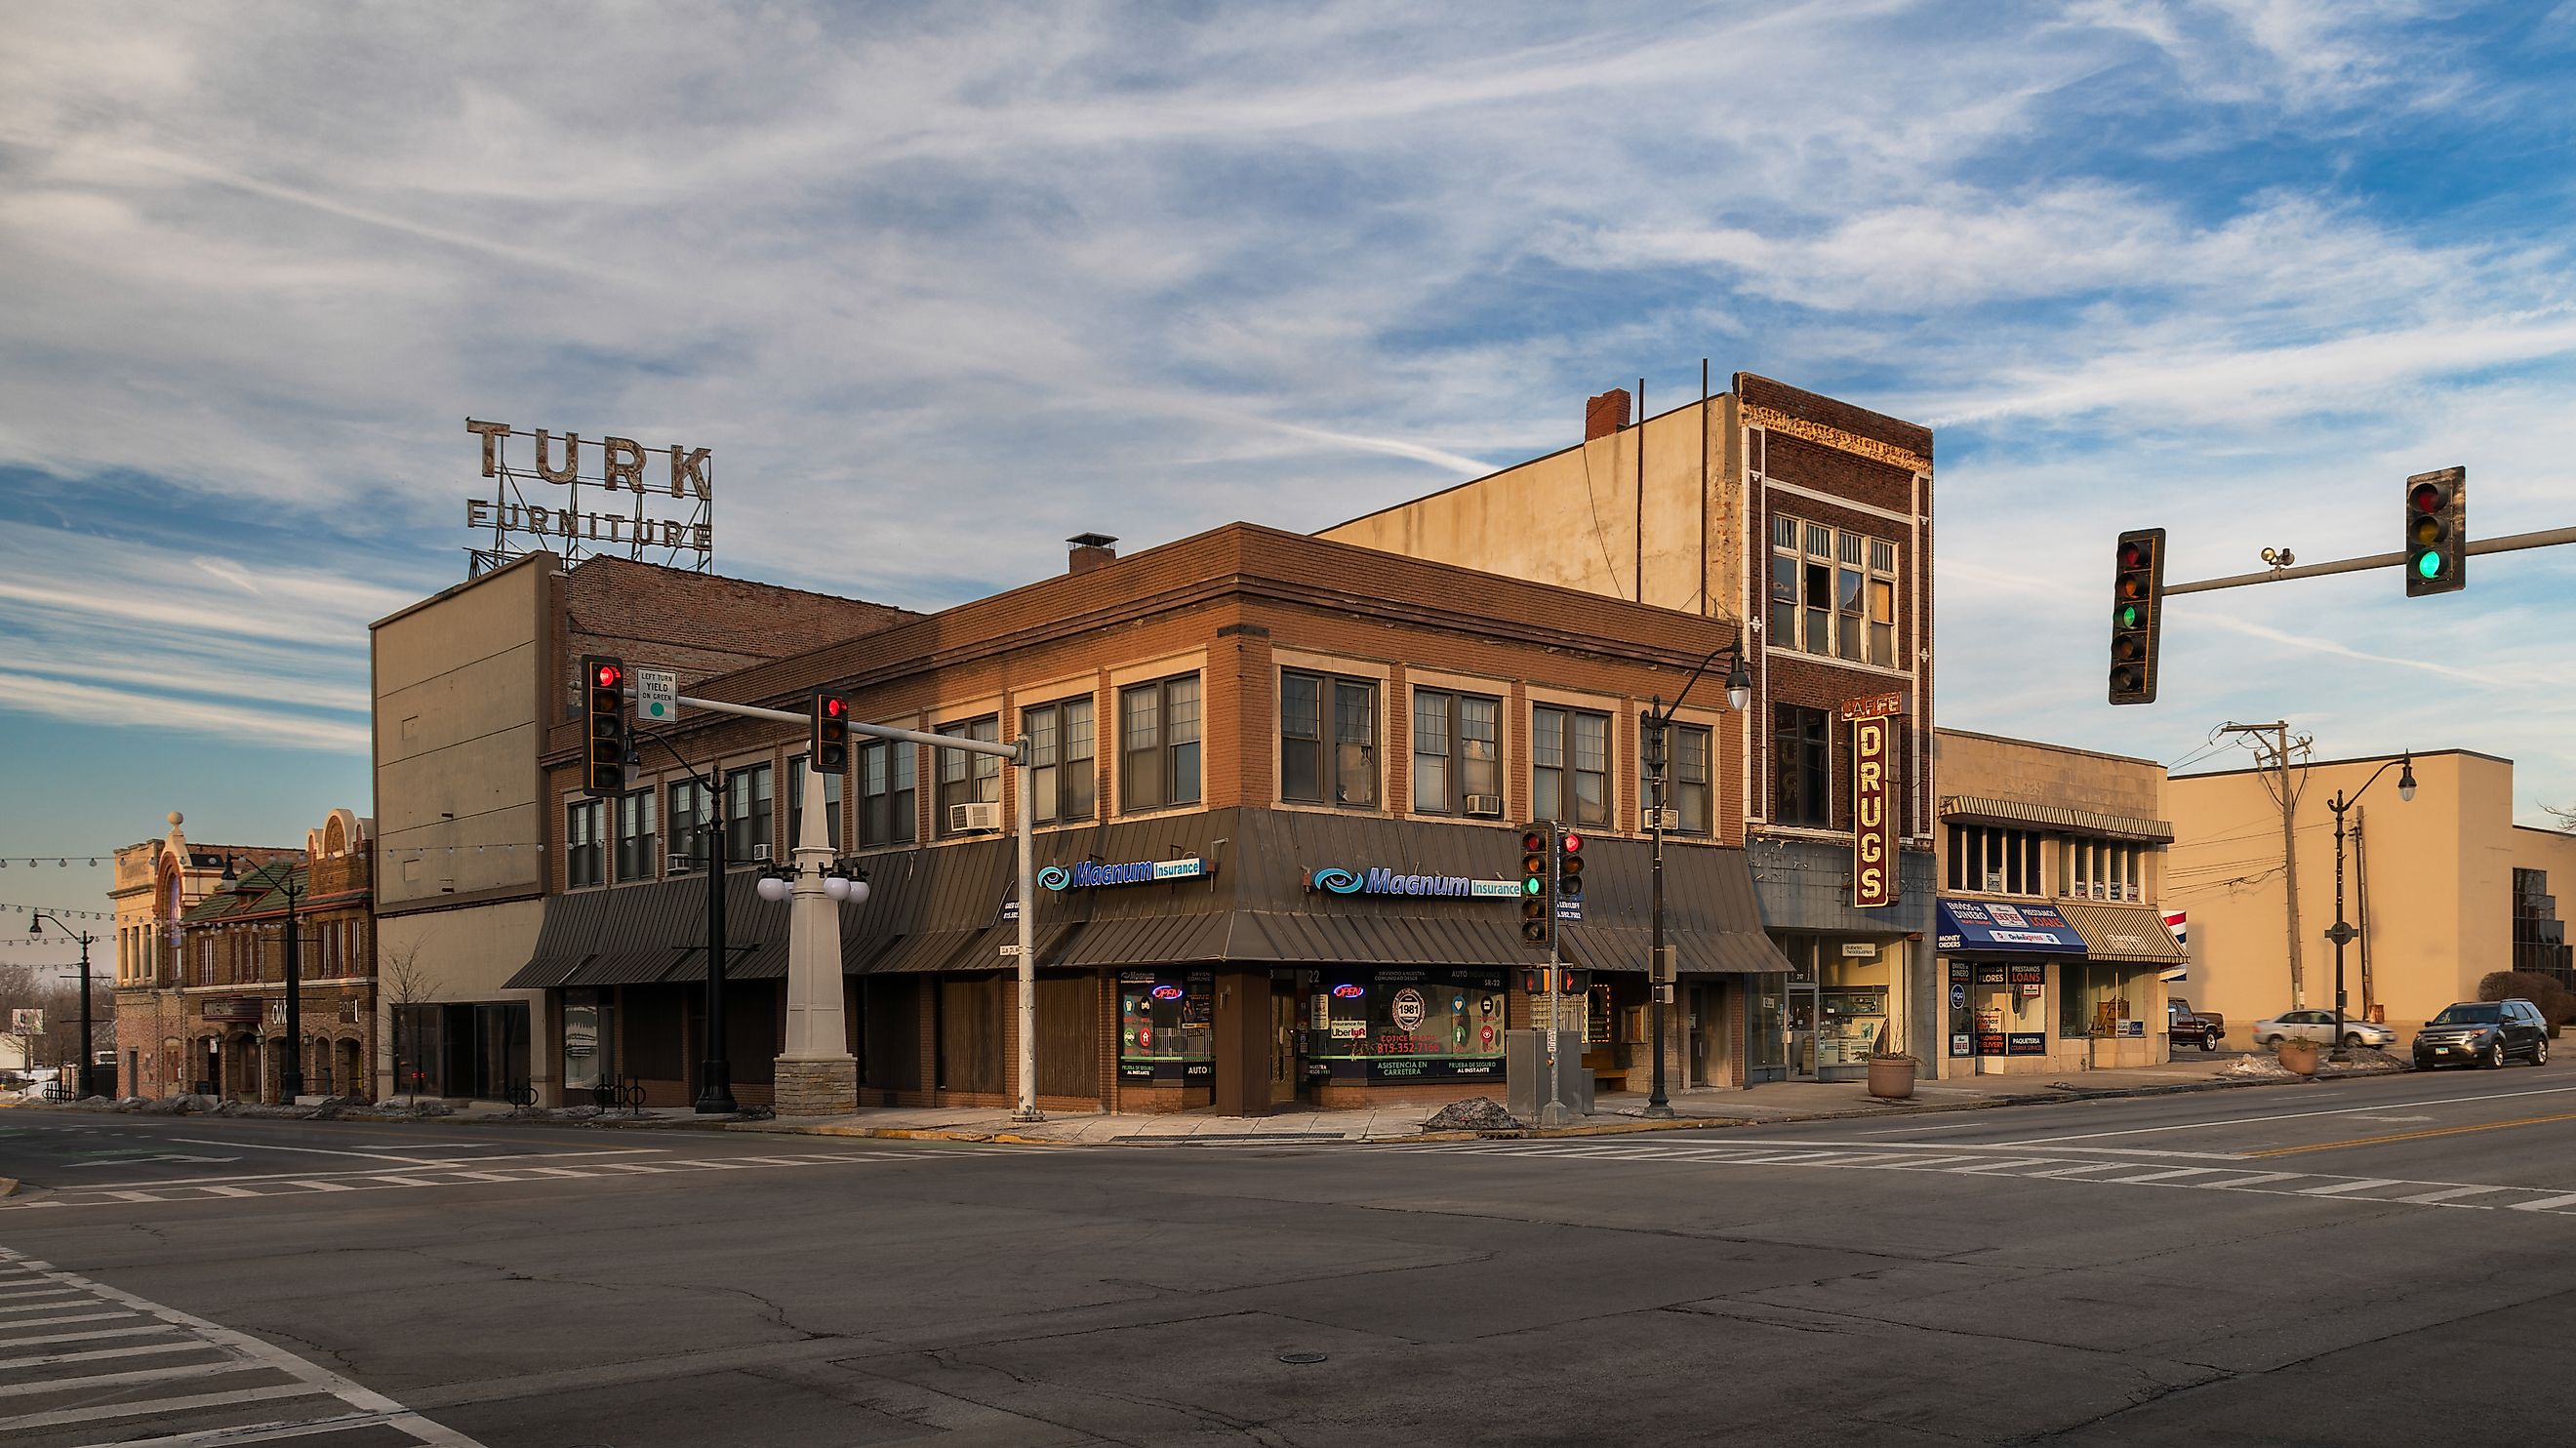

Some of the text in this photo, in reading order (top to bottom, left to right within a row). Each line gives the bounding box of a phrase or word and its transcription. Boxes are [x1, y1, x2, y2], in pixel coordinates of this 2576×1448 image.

[467, 420, 711, 501] TURK
[467, 499, 712, 551] FURNITURE
[646, 682, 668, 692] YIELD
[1842, 696, 1899, 718] JAFFE
[1860, 725, 1881, 899] DRUGS
[1073, 860, 1198, 888] Magnum Insurance
[1366, 866, 1520, 897] Magnum Insurance
[1952, 910, 1988, 920] DINERO
[2029, 916, 2065, 928] LOANS
[1308, 970, 1319, 983] 22
[1978, 974, 2004, 983] FLORES
[2012, 973, 2040, 983] LOANS
[1155, 988, 1181, 997] OPEN
[1335, 986, 1361, 996] OPEN
[1398, 1004, 1419, 1014] 1981
[1332, 1027, 1365, 1038] Uber lyft
[1377, 1043, 1439, 1053] 815-352-7166
